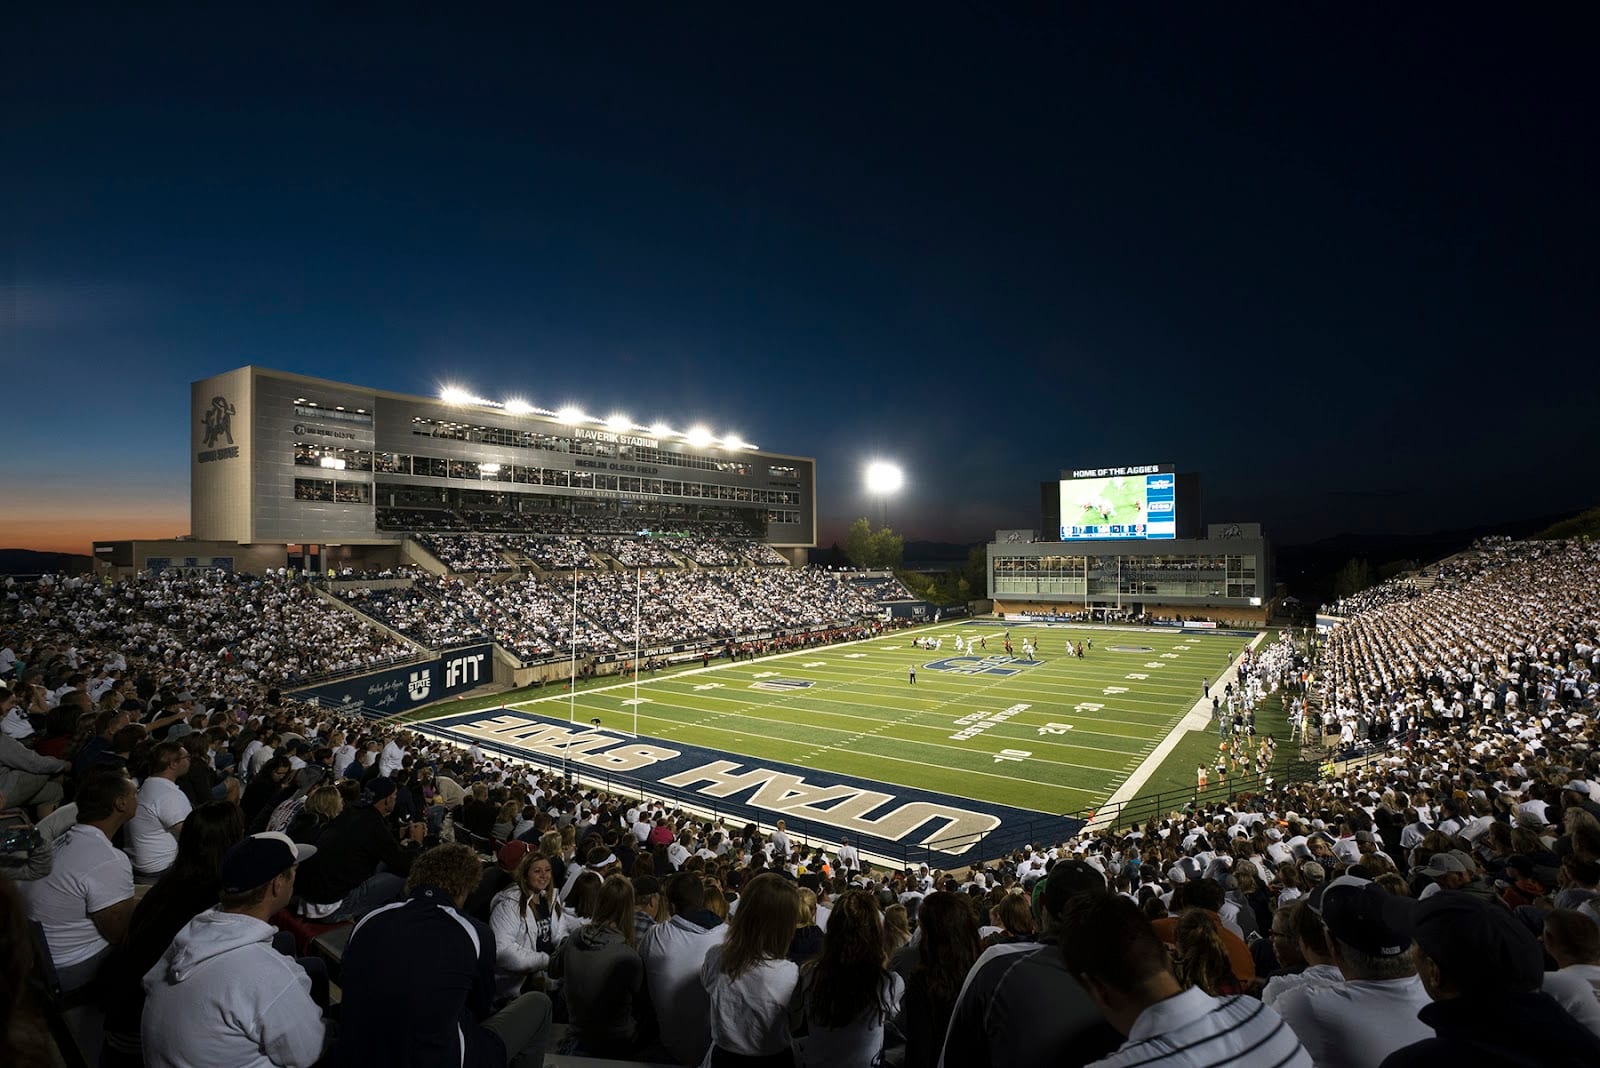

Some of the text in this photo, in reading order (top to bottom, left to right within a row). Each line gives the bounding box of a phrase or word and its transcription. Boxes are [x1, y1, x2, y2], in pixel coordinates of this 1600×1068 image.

[575, 428, 659, 449] MAVERIK STADIUM
[609, 463, 635, 473] OLSEN
[637, 467, 658, 475] FIELD
[1073, 470, 1096, 478] HOME
[1109, 467, 1126, 475] THE
[1127, 465, 1159, 474] AGGIES
[408, 677, 431, 694] STATE
[1038, 722, 1074, 735] 20
[450, 715, 683, 771] STATE
[993, 749, 1033, 762] 10
[658, 759, 1002, 856] UTAH
